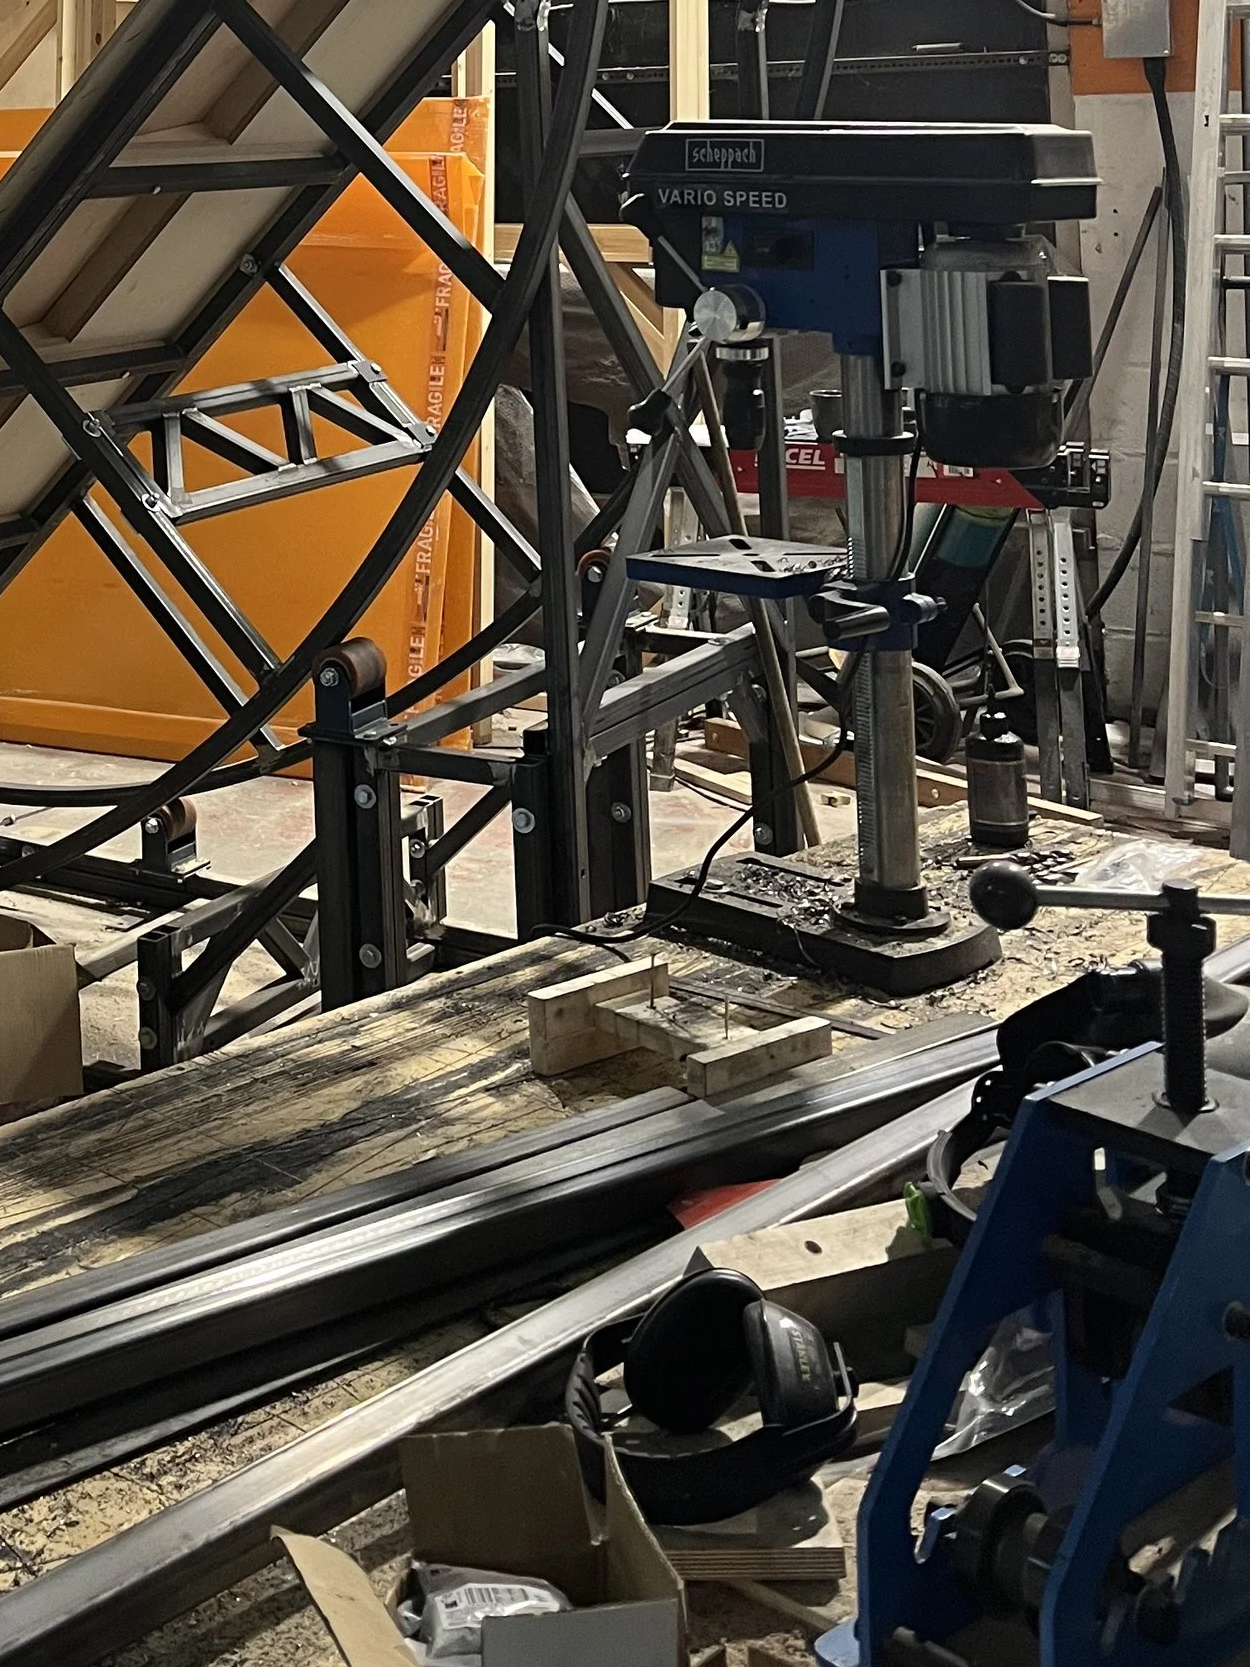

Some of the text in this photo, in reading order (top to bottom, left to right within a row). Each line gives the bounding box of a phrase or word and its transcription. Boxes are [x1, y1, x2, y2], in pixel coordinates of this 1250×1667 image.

[691, 139, 757, 170] scheppach
[658, 188, 787, 209] VARIO SPEED
[426, 364, 446, 430] RAGILE
[790, 1329, 812, 1382] STANLEY
